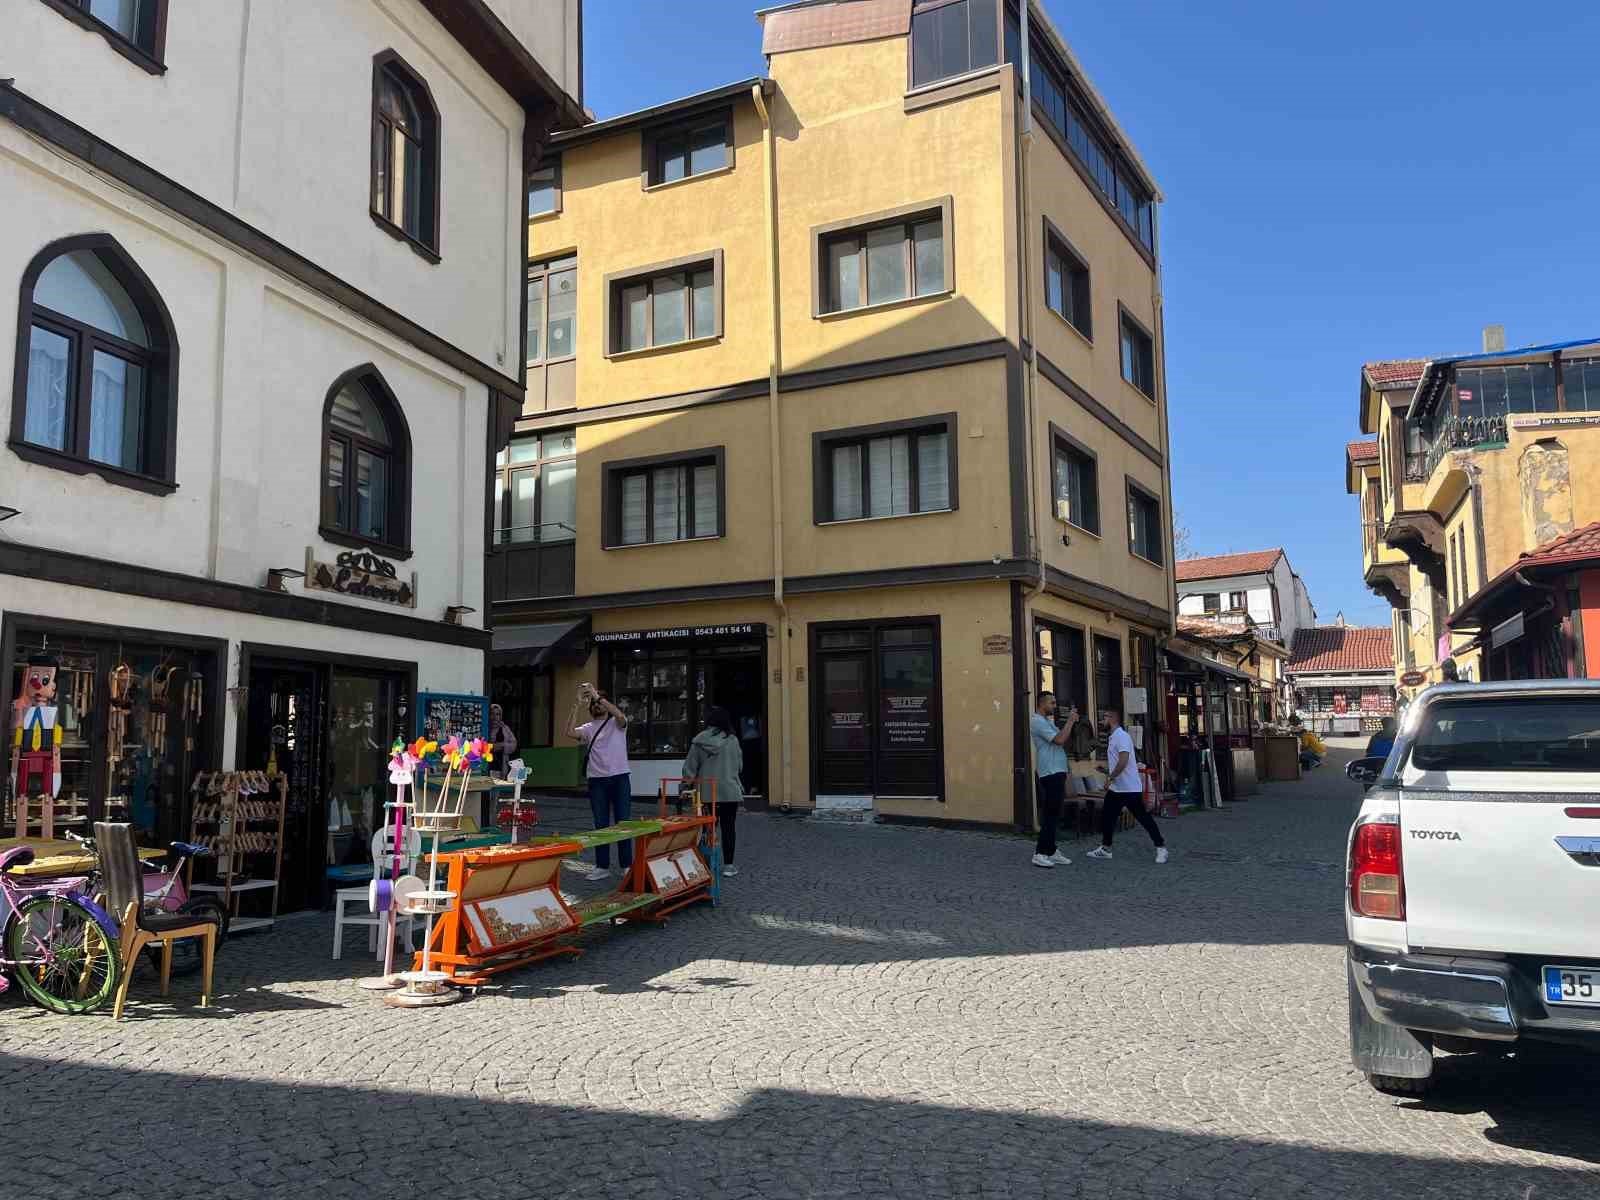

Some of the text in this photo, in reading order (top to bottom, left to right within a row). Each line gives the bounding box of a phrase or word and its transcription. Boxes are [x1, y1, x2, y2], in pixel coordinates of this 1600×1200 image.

[594, 632, 641, 642] ODUNPAZARI
[694, 627, 713, 636] 0543
[1409, 830, 1462, 840] TOYOTA
[1562, 974, 1592, 996] 35
